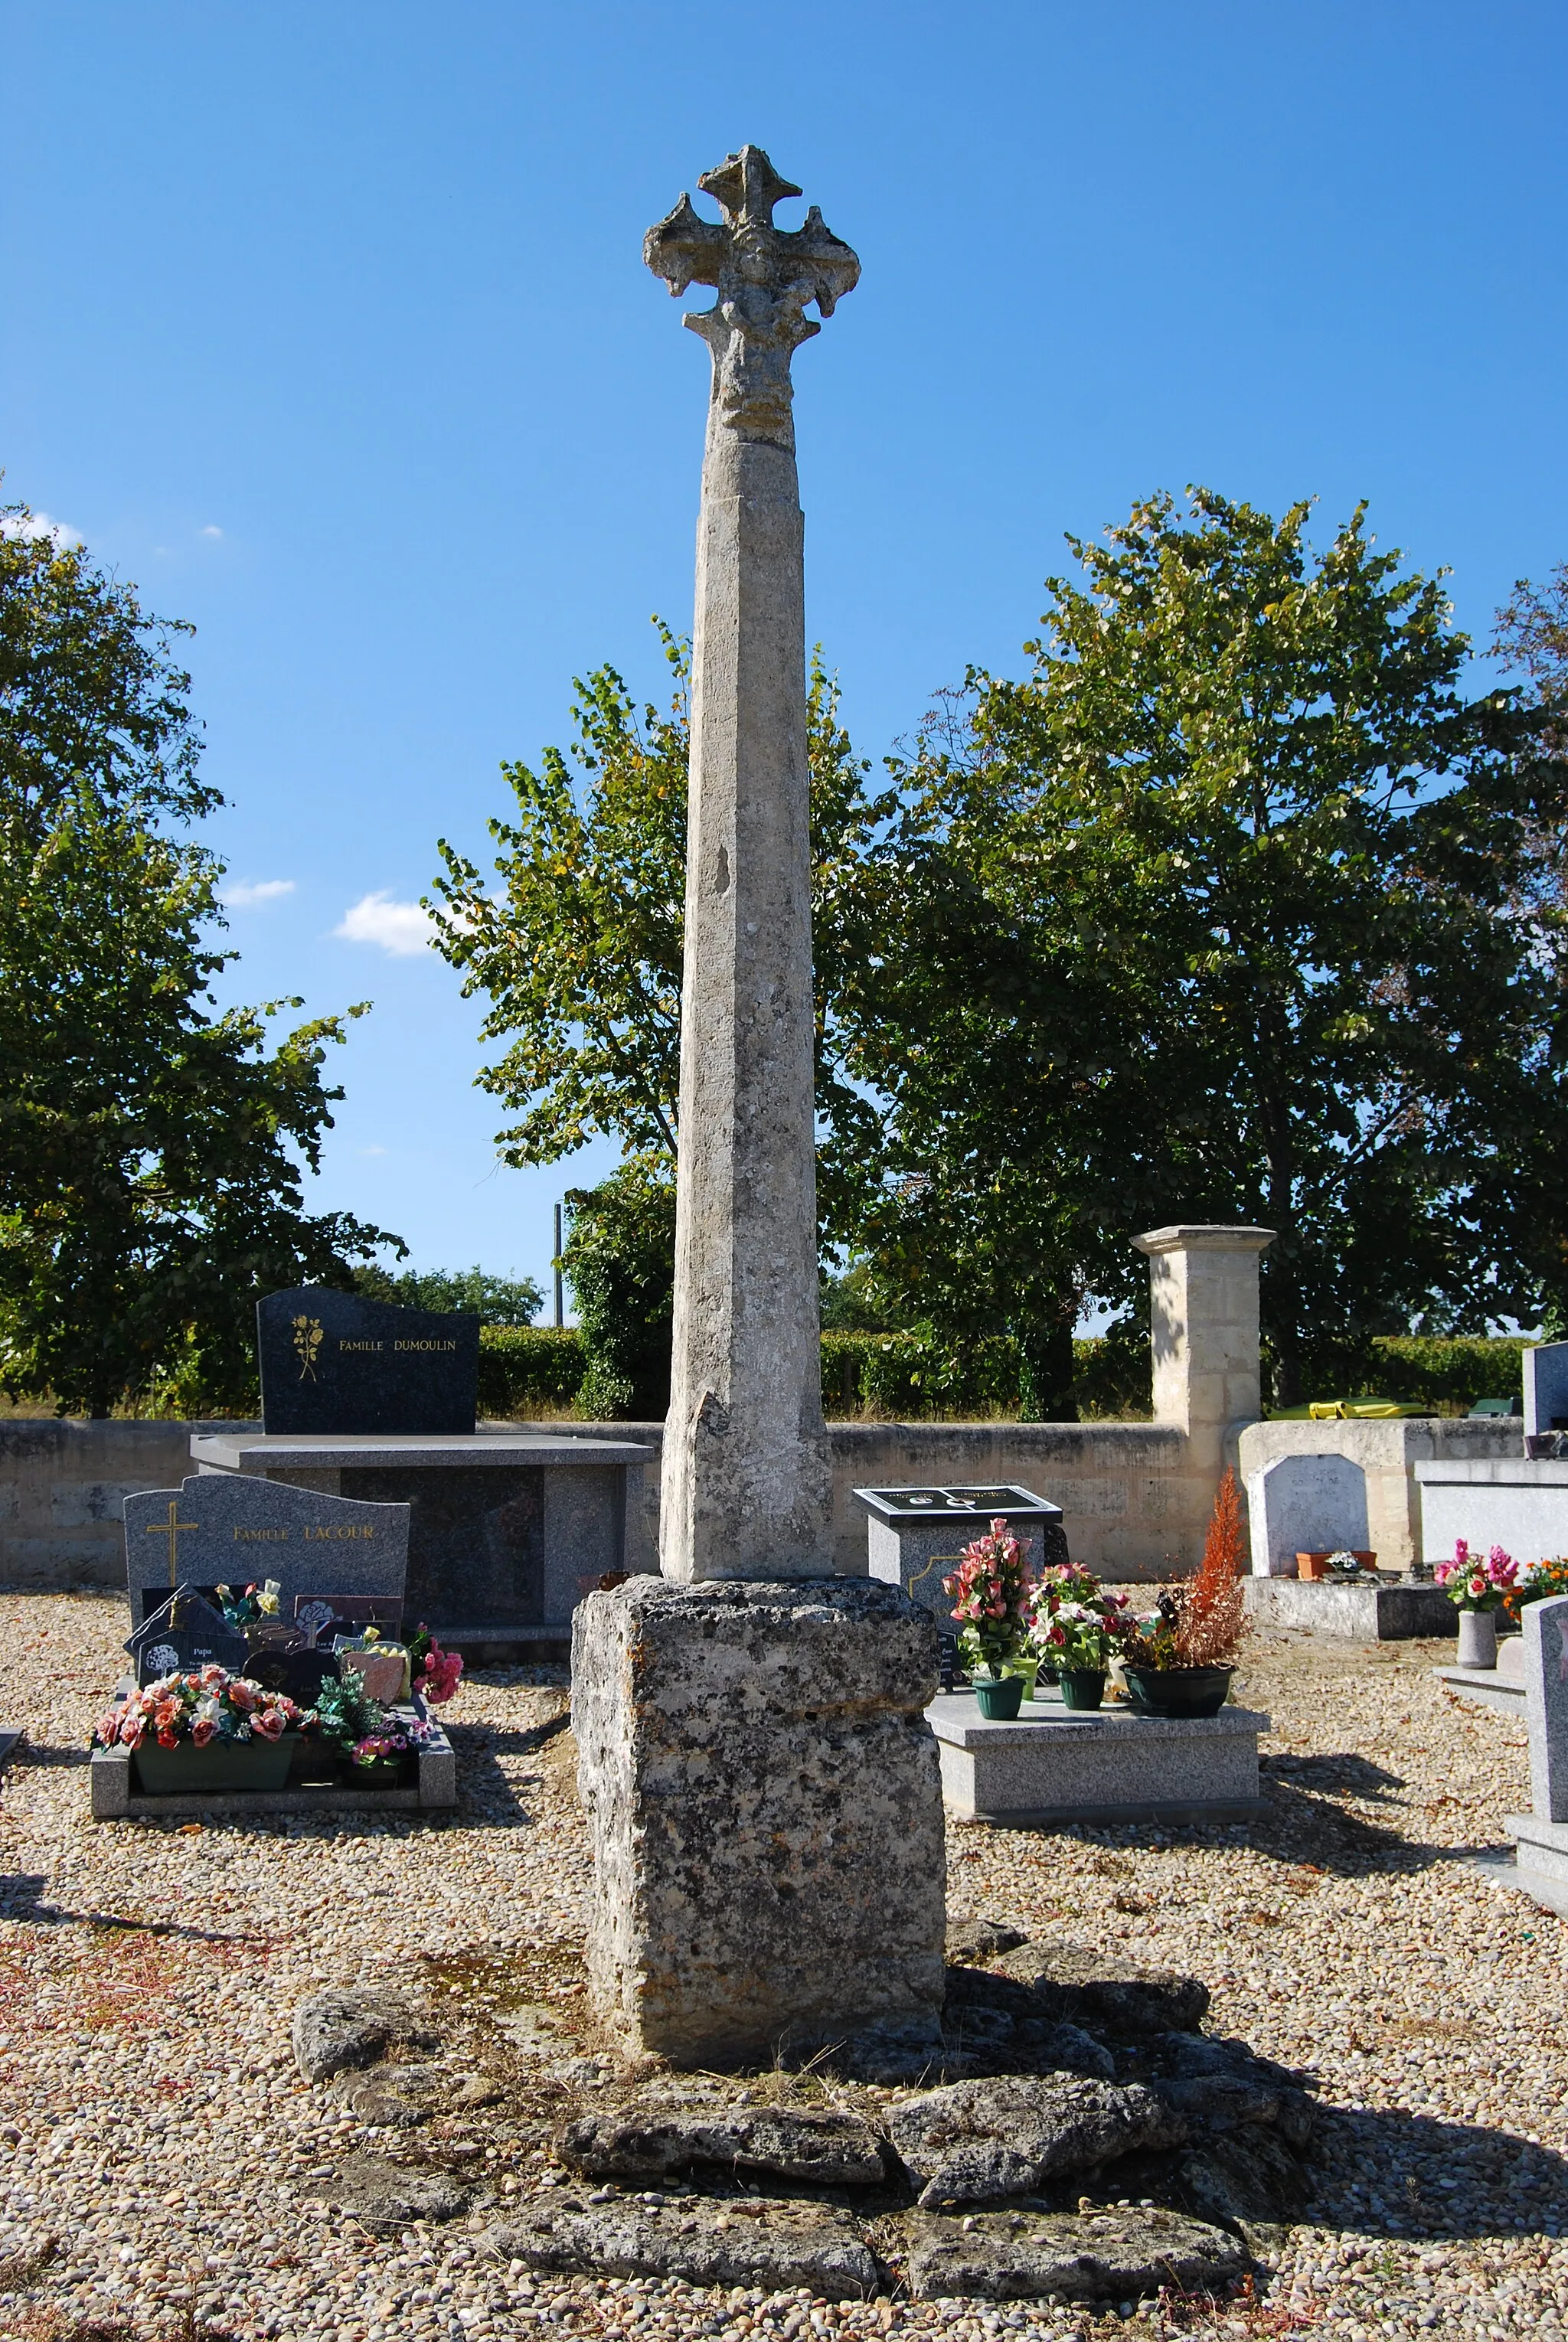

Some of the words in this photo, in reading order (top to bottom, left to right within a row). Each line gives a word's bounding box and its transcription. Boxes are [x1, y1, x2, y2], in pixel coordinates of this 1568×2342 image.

[339, 1340, 384, 1351] FAMILLE
[394, 1340, 456, 1351] DUMOULIN
[233, 1527, 289, 1540] FAMILLE
[305, 1525, 374, 1540] LACOUR
[193, 1648, 212, 1657] Papa
